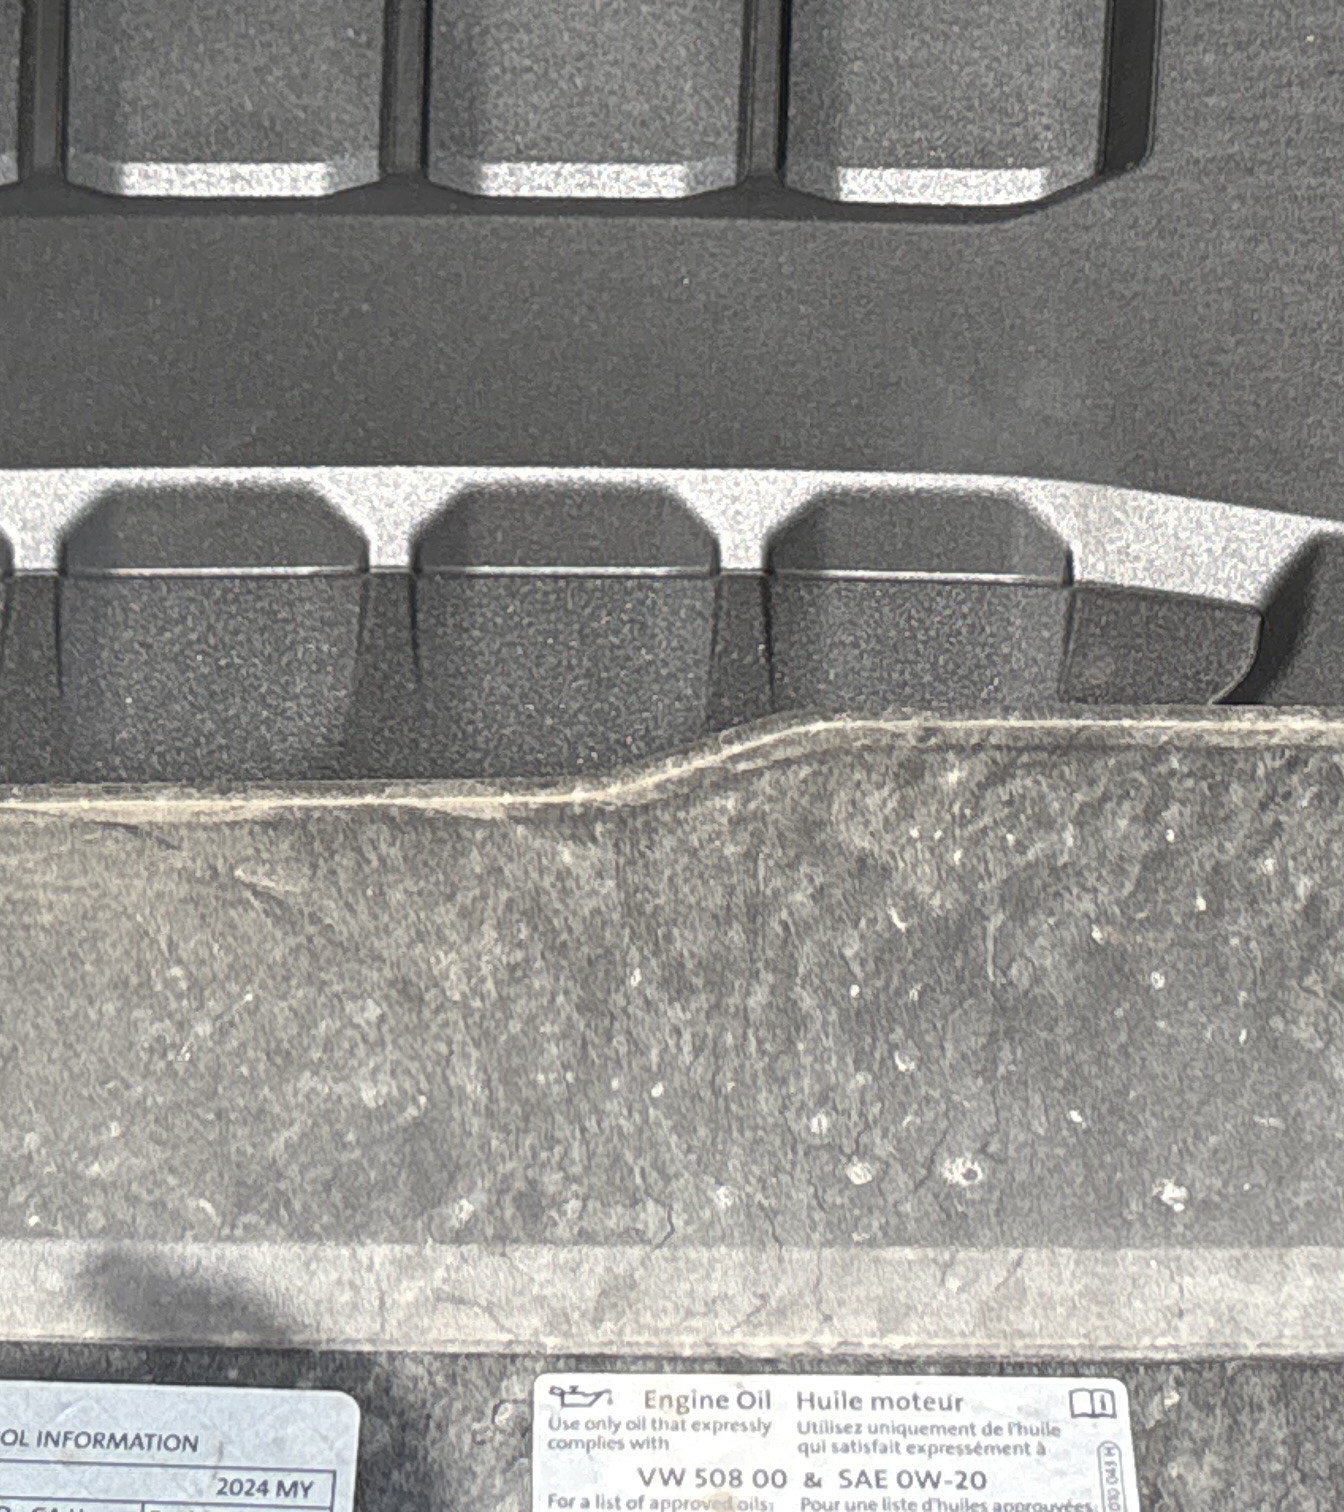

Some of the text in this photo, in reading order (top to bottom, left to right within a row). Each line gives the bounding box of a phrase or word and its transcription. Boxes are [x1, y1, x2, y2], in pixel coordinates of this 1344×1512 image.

[643, 1389, 772, 1415] Engine Oil
[796, 1390, 965, 1412] Huile moteur
[547, 1415, 772, 1437] Use only oil that expressly
[796, 1419, 863, 1436] Utilisez
[867, 1421, 977, 1439] uniquement
[981, 1421, 1004, 1436] de
[35, 1430, 200, 1454] INFORMATION
[547, 1437, 670, 1455] complies with
[796, 1438, 1047, 1460] qui satisfait expressément à
[216, 1478, 315, 1499] 2024 MY
[636, 1467, 989, 1491] VW 508 00 & SAE 0W-20
[547, 1493, 576, 1510] For
[579, 1496, 591, 1509] a
[595, 1493, 622, 1511] list
[625, 1494, 646, 1511] of
[649, 1495, 733, 1512] approved
[800, 1496, 841, 1512] Pour
[844, 1499, 879, 1512] une
[882, 1496, 919, 1512] liste
